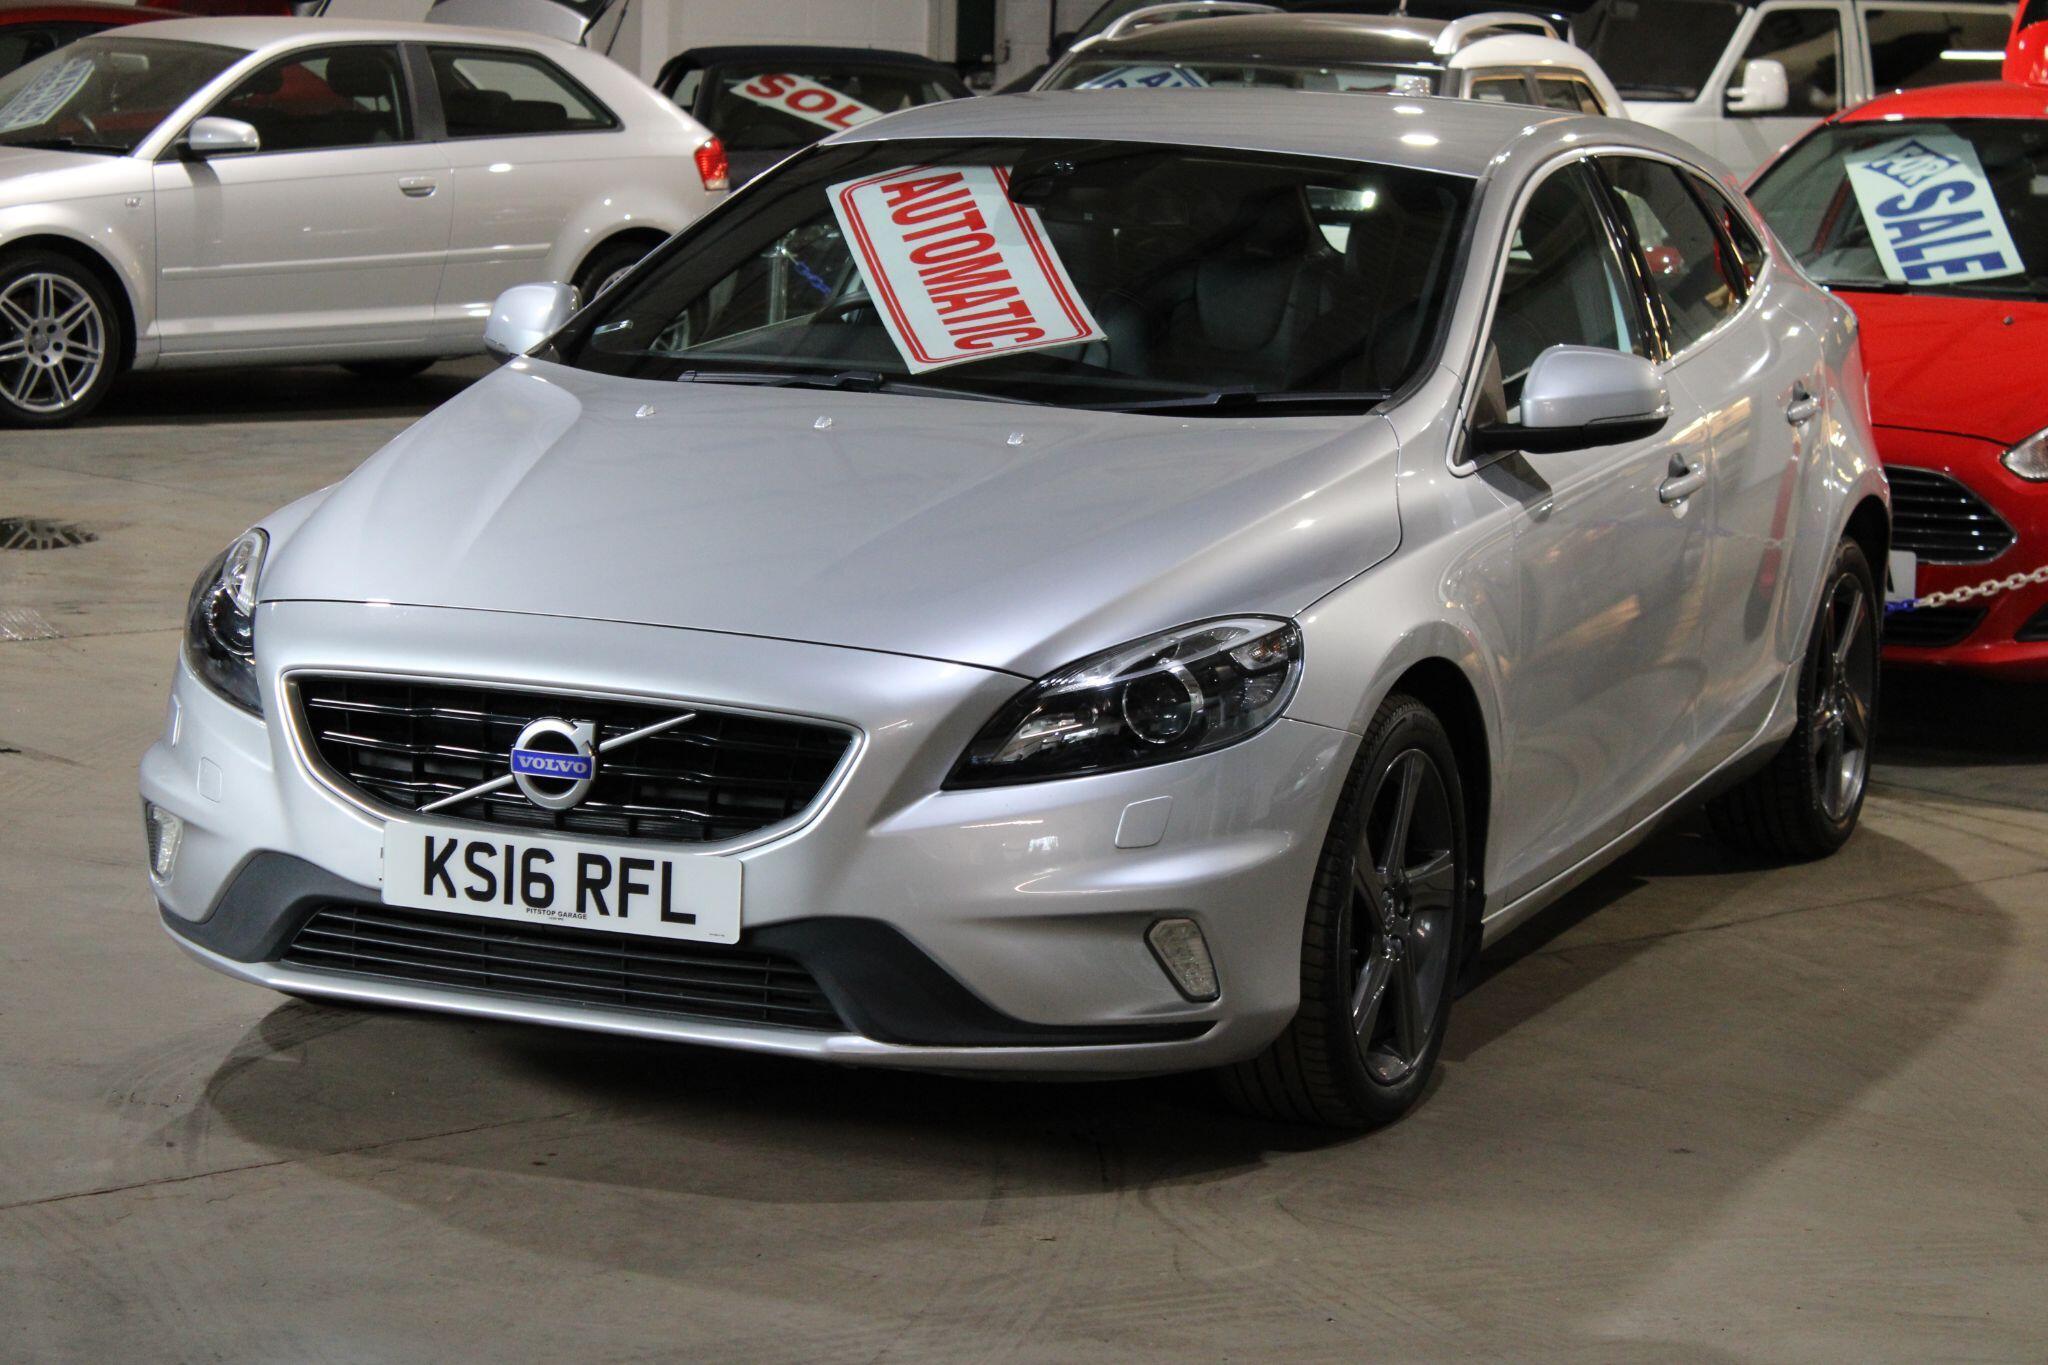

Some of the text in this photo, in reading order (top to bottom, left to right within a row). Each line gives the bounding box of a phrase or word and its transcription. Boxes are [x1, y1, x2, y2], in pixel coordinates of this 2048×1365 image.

[745, 73, 862, 129] SOL
[1869, 145, 1950, 186] FOR
[1875, 180, 2008, 281] SALE
[880, 172, 1046, 350] AUTOMATIC
[517, 755, 588, 774] VOLVO
[423, 835, 697, 925] KS16 RFL
[526, 907, 556, 916] PITSTOP
[557, 910, 588, 920] GARAGE
